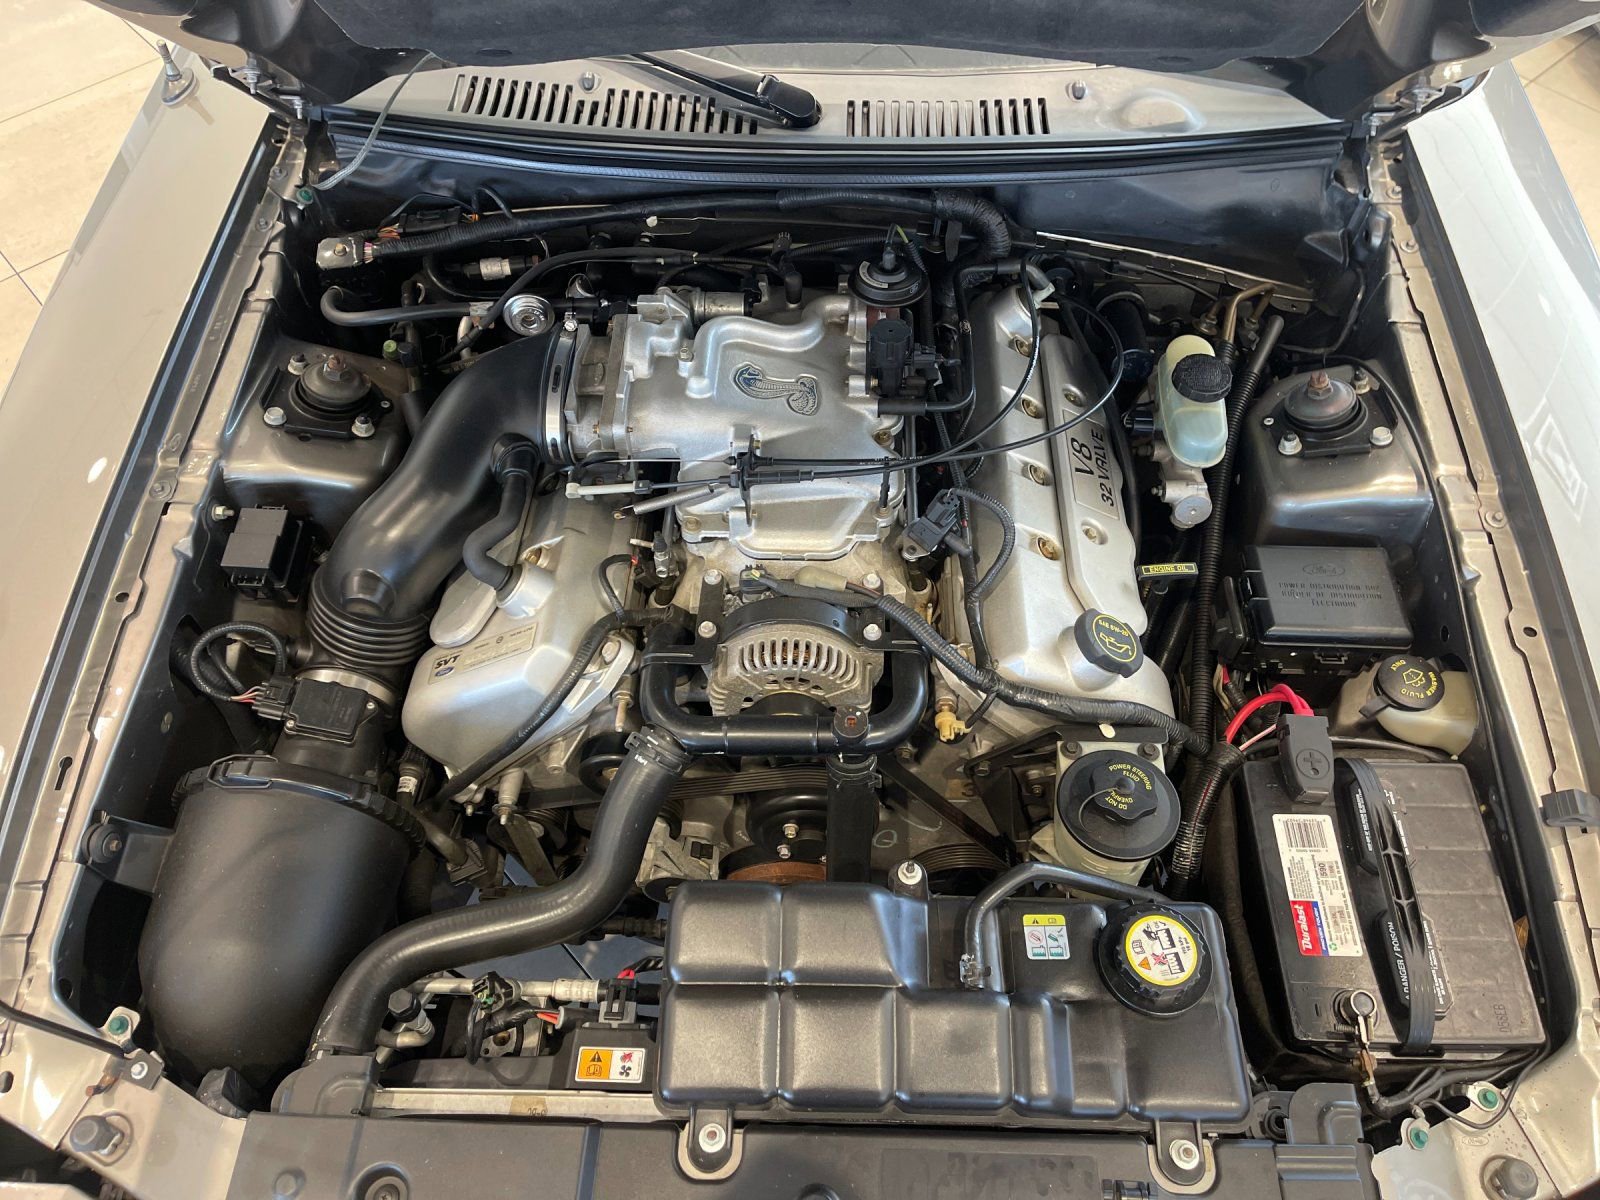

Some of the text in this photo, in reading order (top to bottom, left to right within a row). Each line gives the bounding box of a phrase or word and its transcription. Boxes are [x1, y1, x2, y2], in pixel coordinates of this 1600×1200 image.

[1071, 437, 1094, 475] V8
[1091, 428, 1114, 507] 32 VALVE
[1150, 563, 1188, 573] ENGINE OIL
[1099, 619, 1110, 629] SAE
[434, 654, 461, 670] SVT
[1390, 659, 1406, 671] ONLY
[1401, 671, 1438, 699] WASHER FLUID
[1108, 763, 1152, 790] POWER STEERING
[1122, 770, 1140, 782] FLUID
[1105, 796, 1118, 807] NOT
[1318, 862, 1327, 877] 590
[1313, 907, 1321, 926] TOUGH
[1294, 903, 1313, 951] Duralast
[1387, 921, 1401, 951] POISON
[1396, 959, 1410, 993] DANGER
